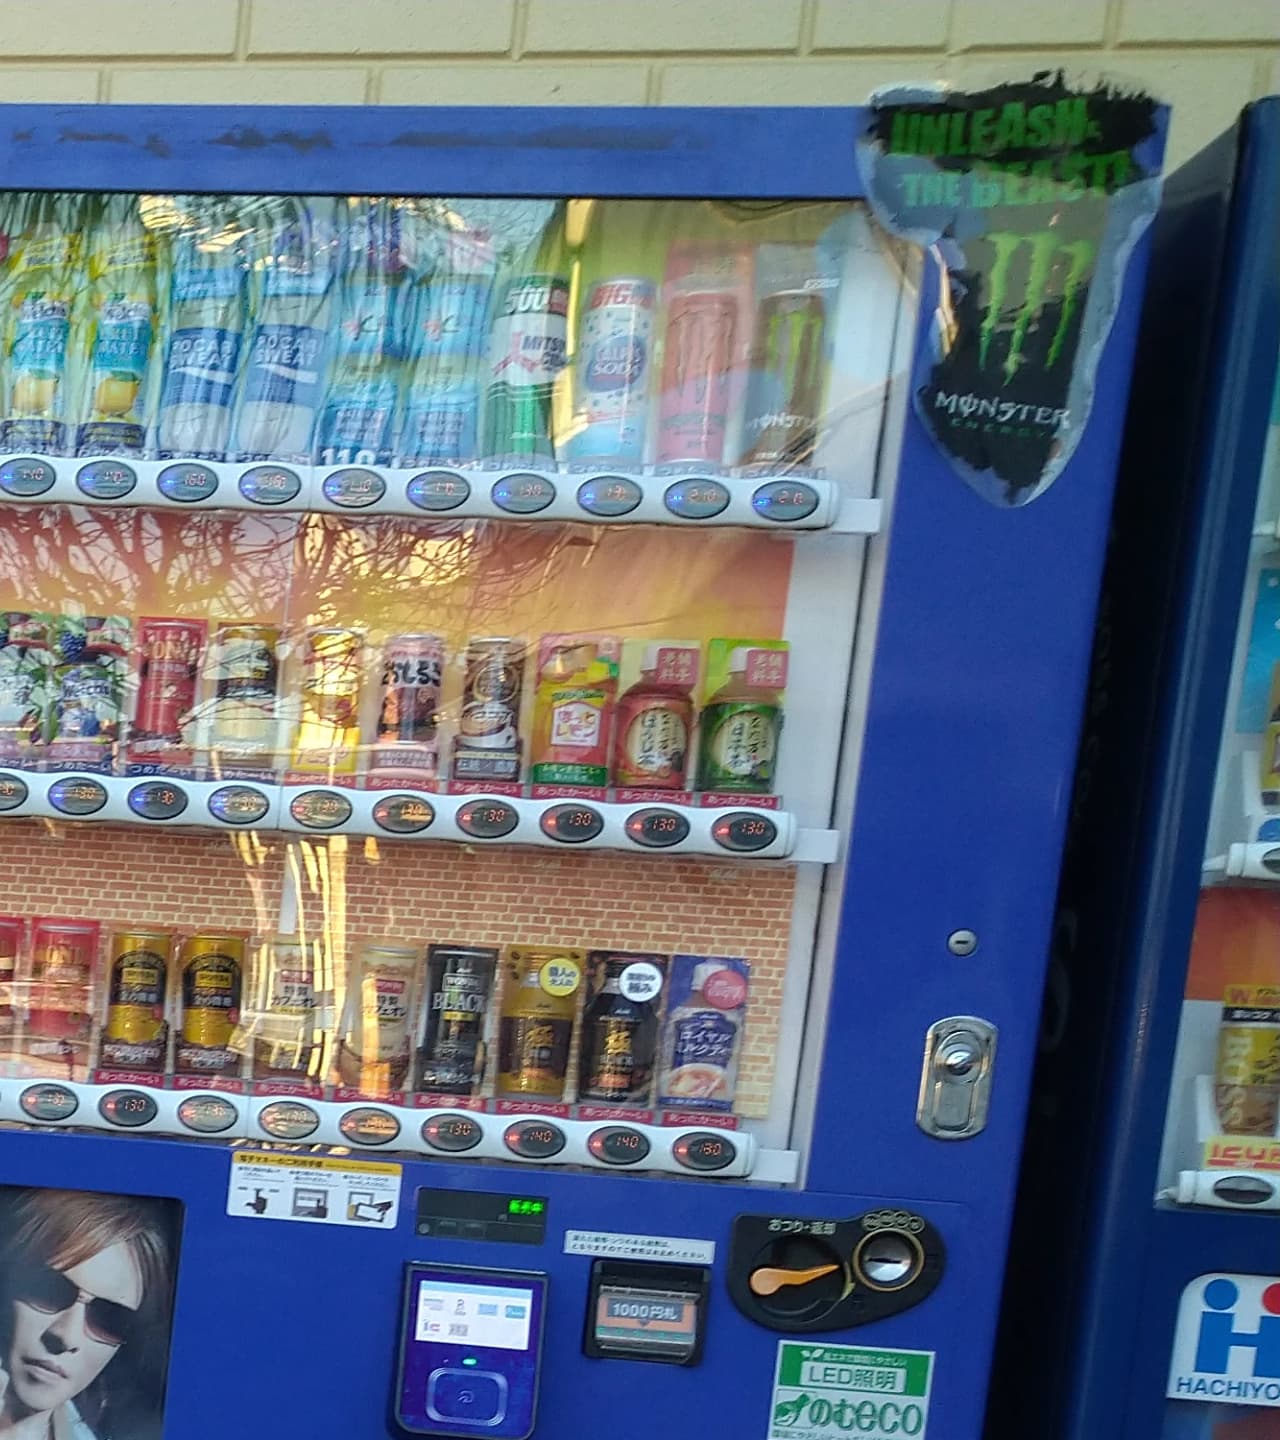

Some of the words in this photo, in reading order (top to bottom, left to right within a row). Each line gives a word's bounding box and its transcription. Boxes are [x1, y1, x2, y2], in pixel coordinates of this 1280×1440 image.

[890, 98, 1092, 157] UNLEASH
[903, 172, 961, 208] THE
[935, 391, 1073, 429] MONSTER
[482, 808, 506, 823] 130
[568, 812, 593, 827] 130
[652, 817, 677, 833] 130
[740, 820, 766, 835] 130
[123, 1099, 147, 1113] 130
[528, 1126, 553, 1143] 140
[615, 1131, 640, 1148] 140
[611, 1301, 678, 1321] 1000円札
[809, 1366, 898, 1390] LED照明
